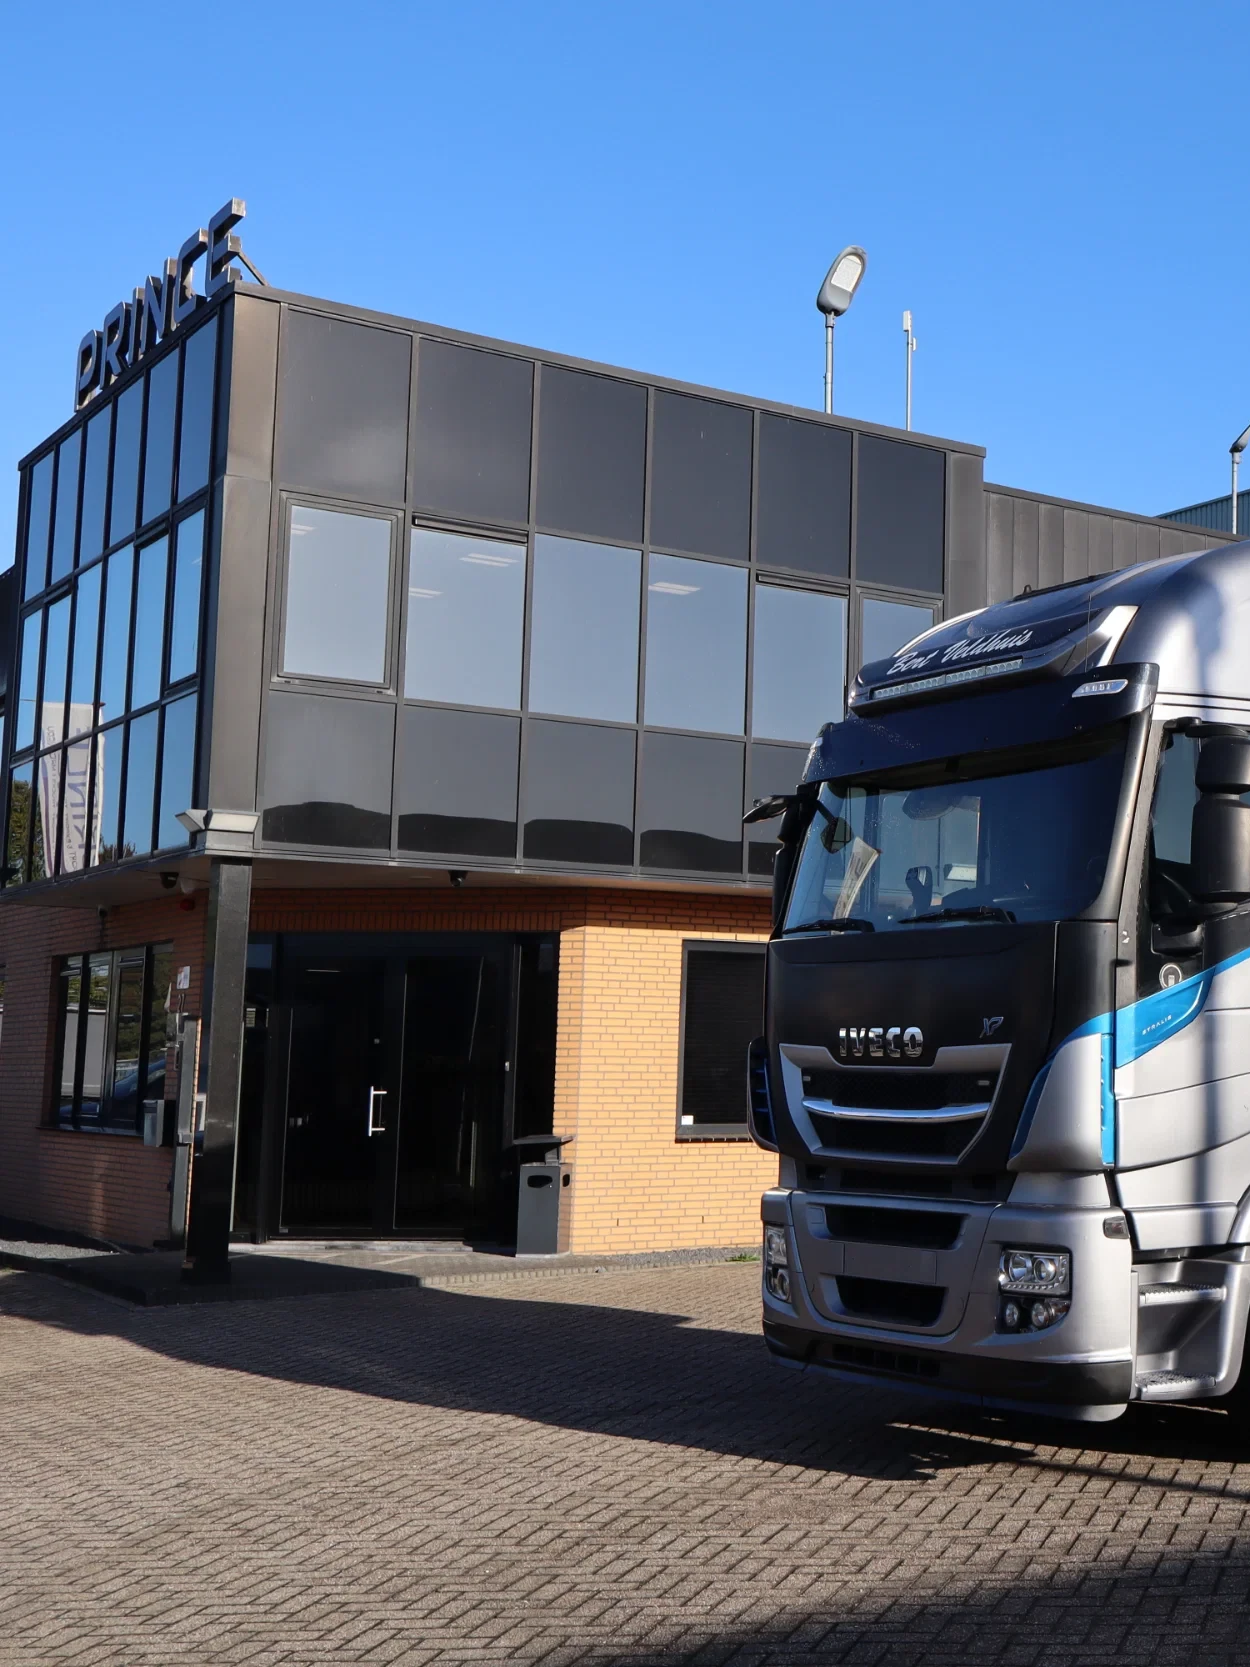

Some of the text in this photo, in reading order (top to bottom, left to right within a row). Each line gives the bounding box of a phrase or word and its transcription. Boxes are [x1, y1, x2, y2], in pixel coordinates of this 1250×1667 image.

[75, 197, 246, 413] PRINCE
[942, 628, 1033, 663] Veldhuis
[1142, 1014, 1172, 1035] STRALIS
[839, 1026, 924, 1058] IVECO
